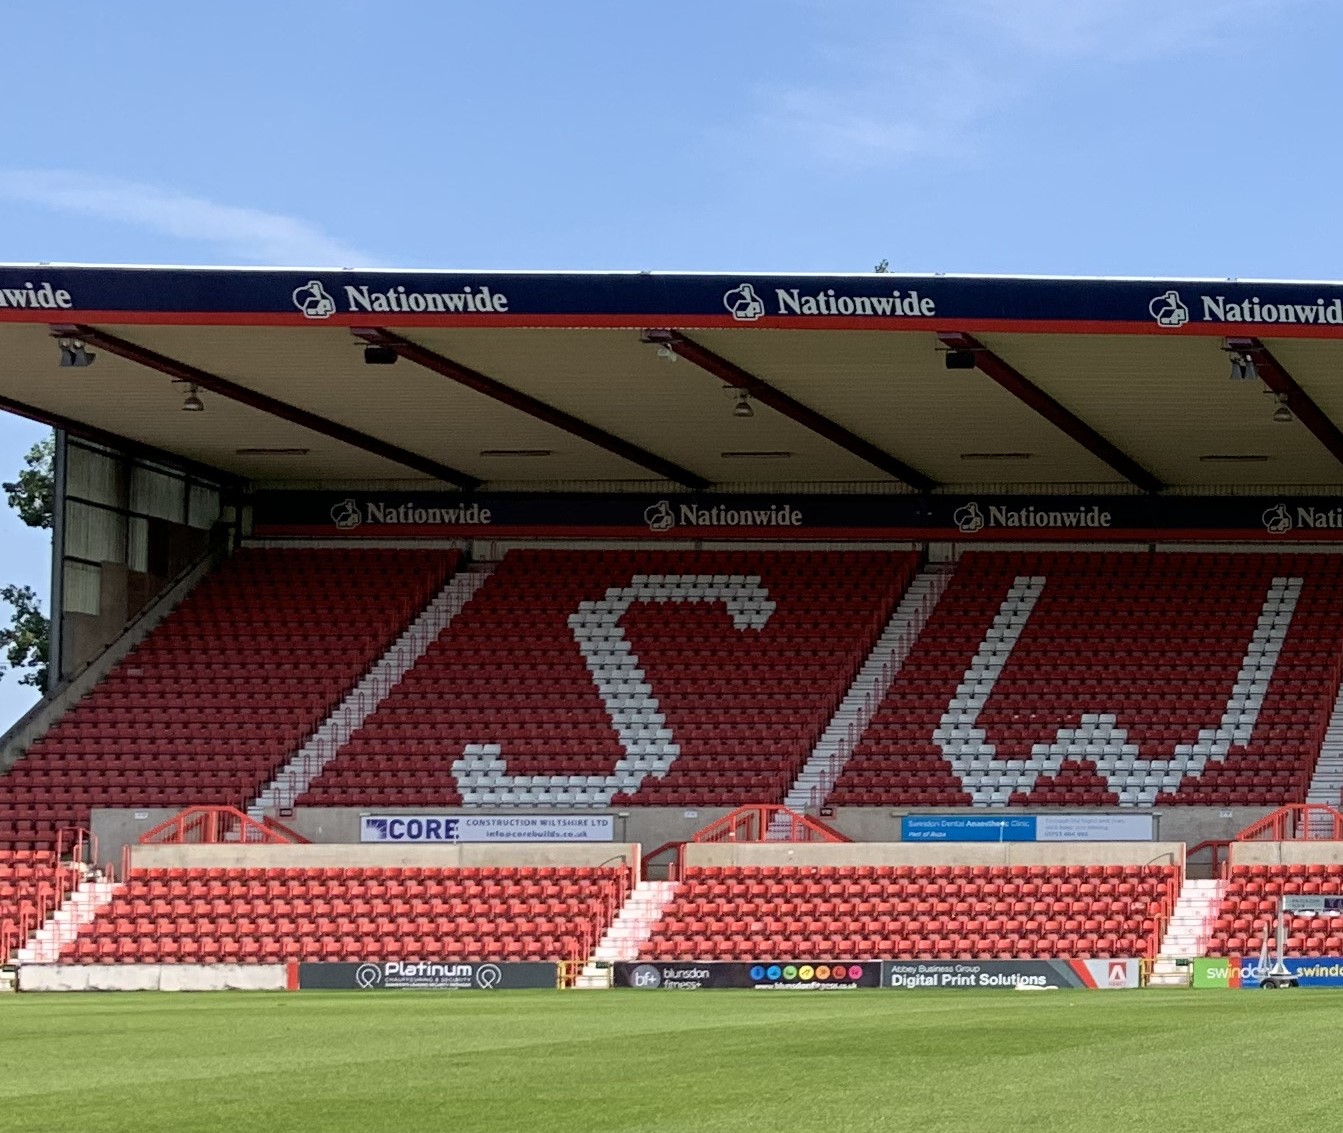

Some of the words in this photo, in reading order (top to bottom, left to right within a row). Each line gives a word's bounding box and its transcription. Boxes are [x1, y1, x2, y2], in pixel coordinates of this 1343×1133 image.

[344, 286, 508, 313] Nationwide
[776, 289, 936, 317] Nationwide
[366, 502, 492, 524] Nationwide
[680, 504, 803, 527] Nationwide
[989, 506, 1112, 528] Nationwide
[389, 818, 459, 840] CORE
[466, 819, 537, 827] CONSTRUCTION
[539, 819, 589, 827] WILTSHIRE
[591, 819, 609, 827] LTD
[385, 962, 473, 977] Platinum
[635, 970, 657, 988] bf+
[664, 967, 710, 979] blunsdon
[891, 965, 918, 975] Abbey
[918, 965, 952, 973] Business
[952, 965, 980, 974] Group
[891, 974, 938, 988] Digital
[941, 973, 977, 986] Print
[980, 974, 1047, 987] Solutions
